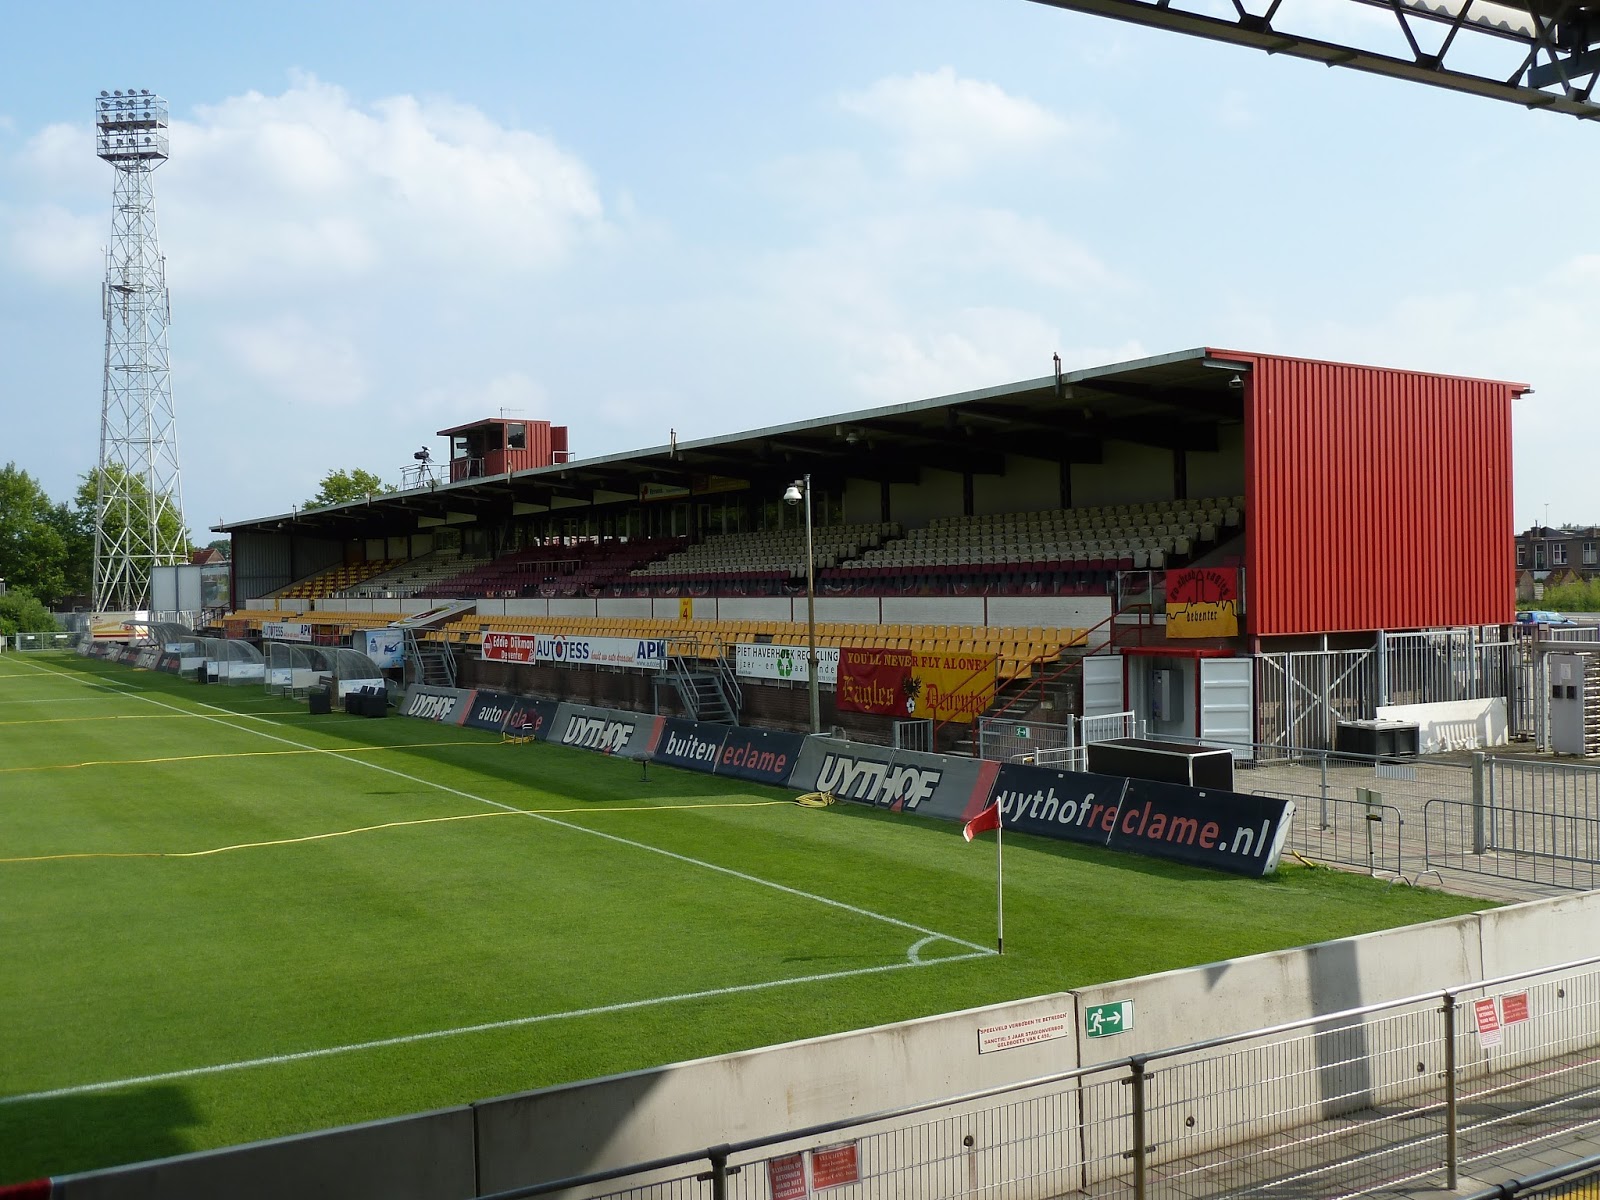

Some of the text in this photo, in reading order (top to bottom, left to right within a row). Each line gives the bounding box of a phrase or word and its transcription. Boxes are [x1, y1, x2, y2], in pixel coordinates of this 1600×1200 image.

[683, 607, 688, 619] 4
[493, 635, 508, 648] Eddie
[510, 636, 534, 650] Dijkman
[536, 638, 590, 661] AUTOTESS
[637, 640, 665, 660] APK
[501, 649, 523, 660] Deventer
[737, 646, 839, 662] PIET HAVERHOEK RECCLING
[848, 651, 988, 672] YOU'LL NEVER FLY ALONE!
[843, 675, 894, 710] Eagles
[408, 693, 456, 721] UYTHOF
[563, 716, 635, 753] UYTHOF
[816, 755, 941, 809] UYTHOF
[1001, 787, 1271, 858] uythofreclame.nl
[775, 1186, 805, 1198] TOEGESTAAN
